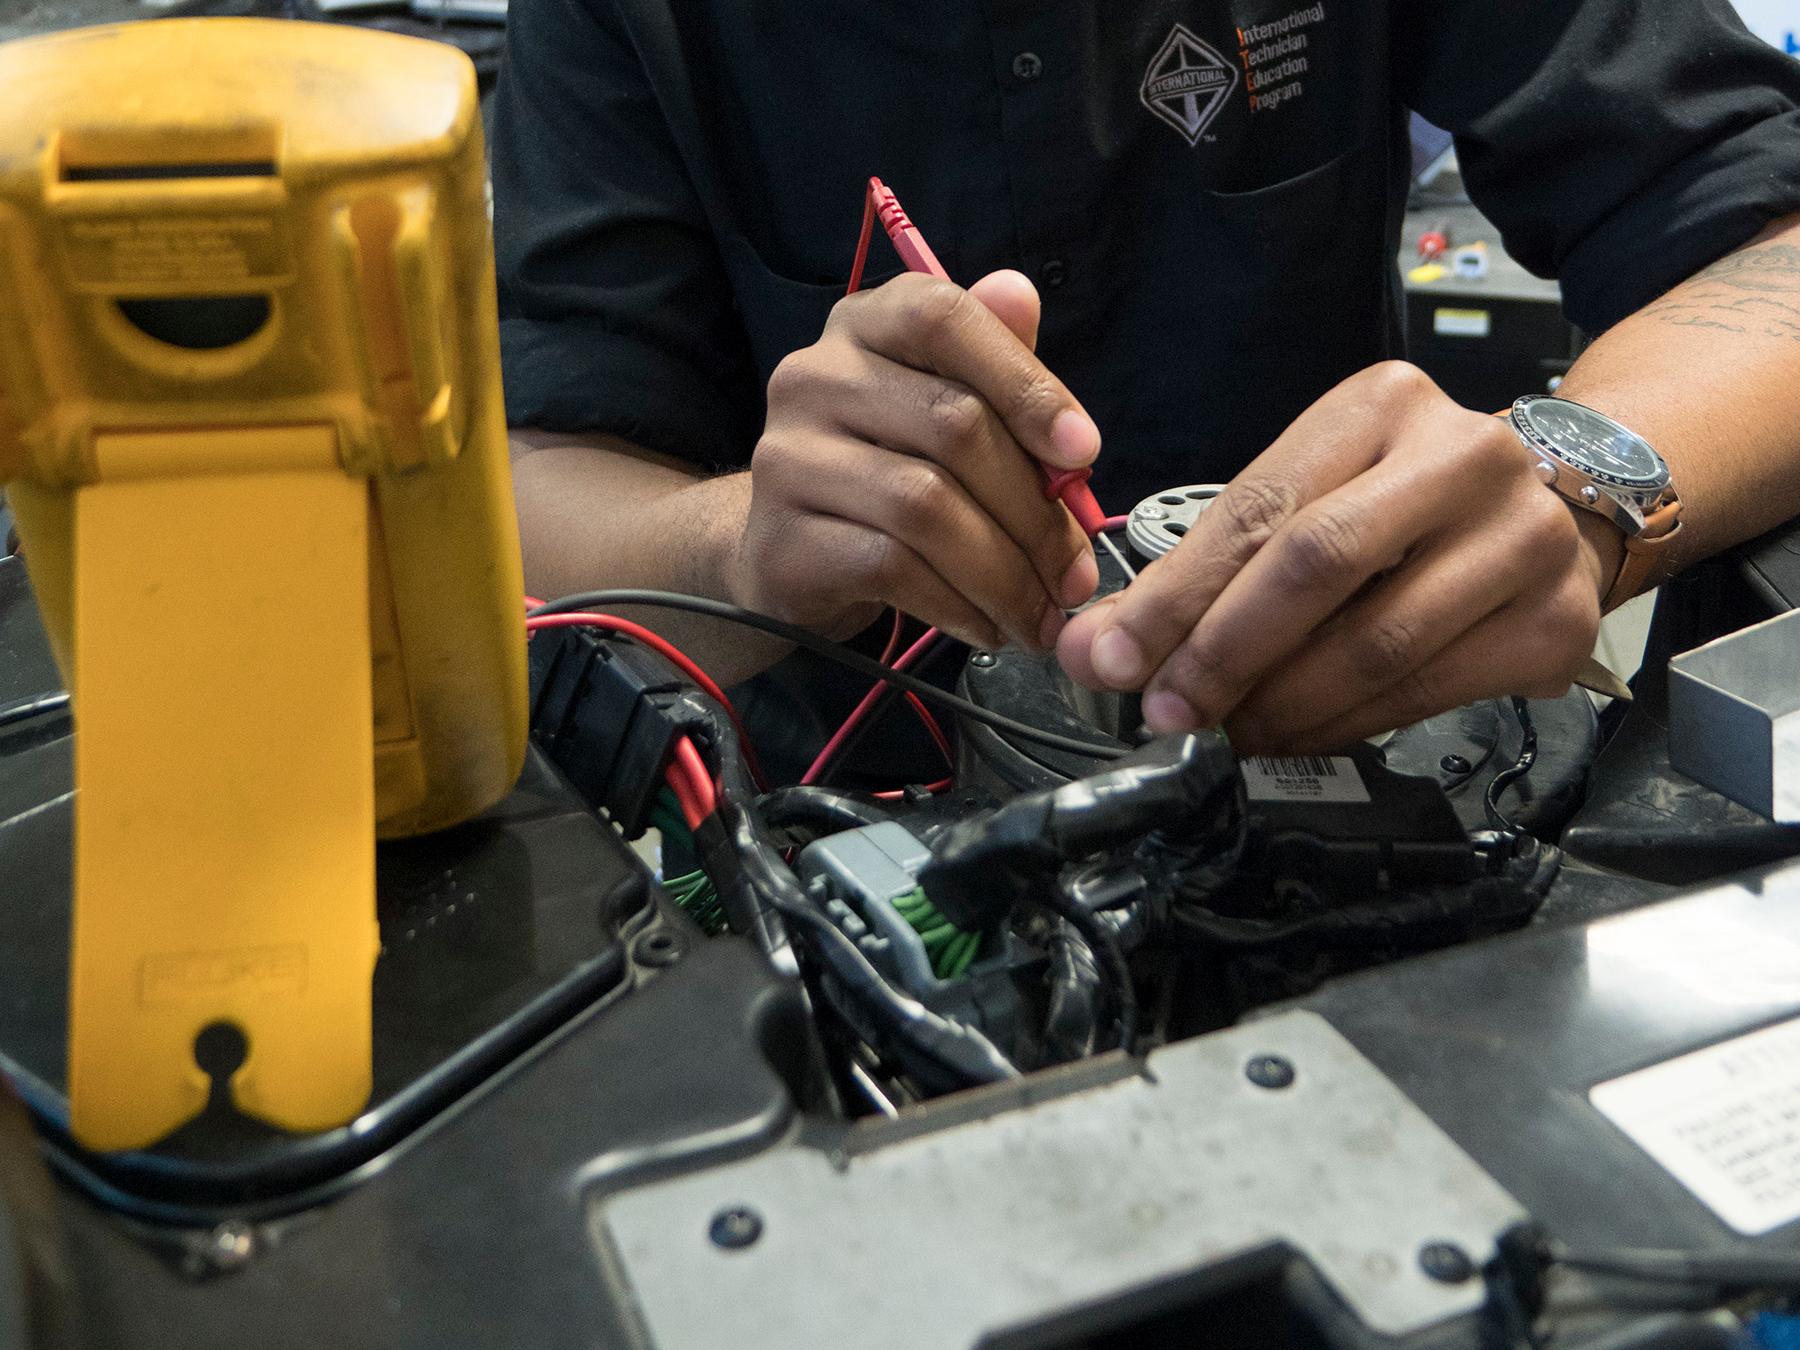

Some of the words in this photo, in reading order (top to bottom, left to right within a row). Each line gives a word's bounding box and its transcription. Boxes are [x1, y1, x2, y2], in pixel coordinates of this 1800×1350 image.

[1236, 2, 1325, 46] International
[1239, 34, 1307, 68] Technician
[1149, 70, 1226, 96] INTERNATIONAL
[1246, 57, 1308, 91] Education
[1249, 82, 1302, 113] Program
